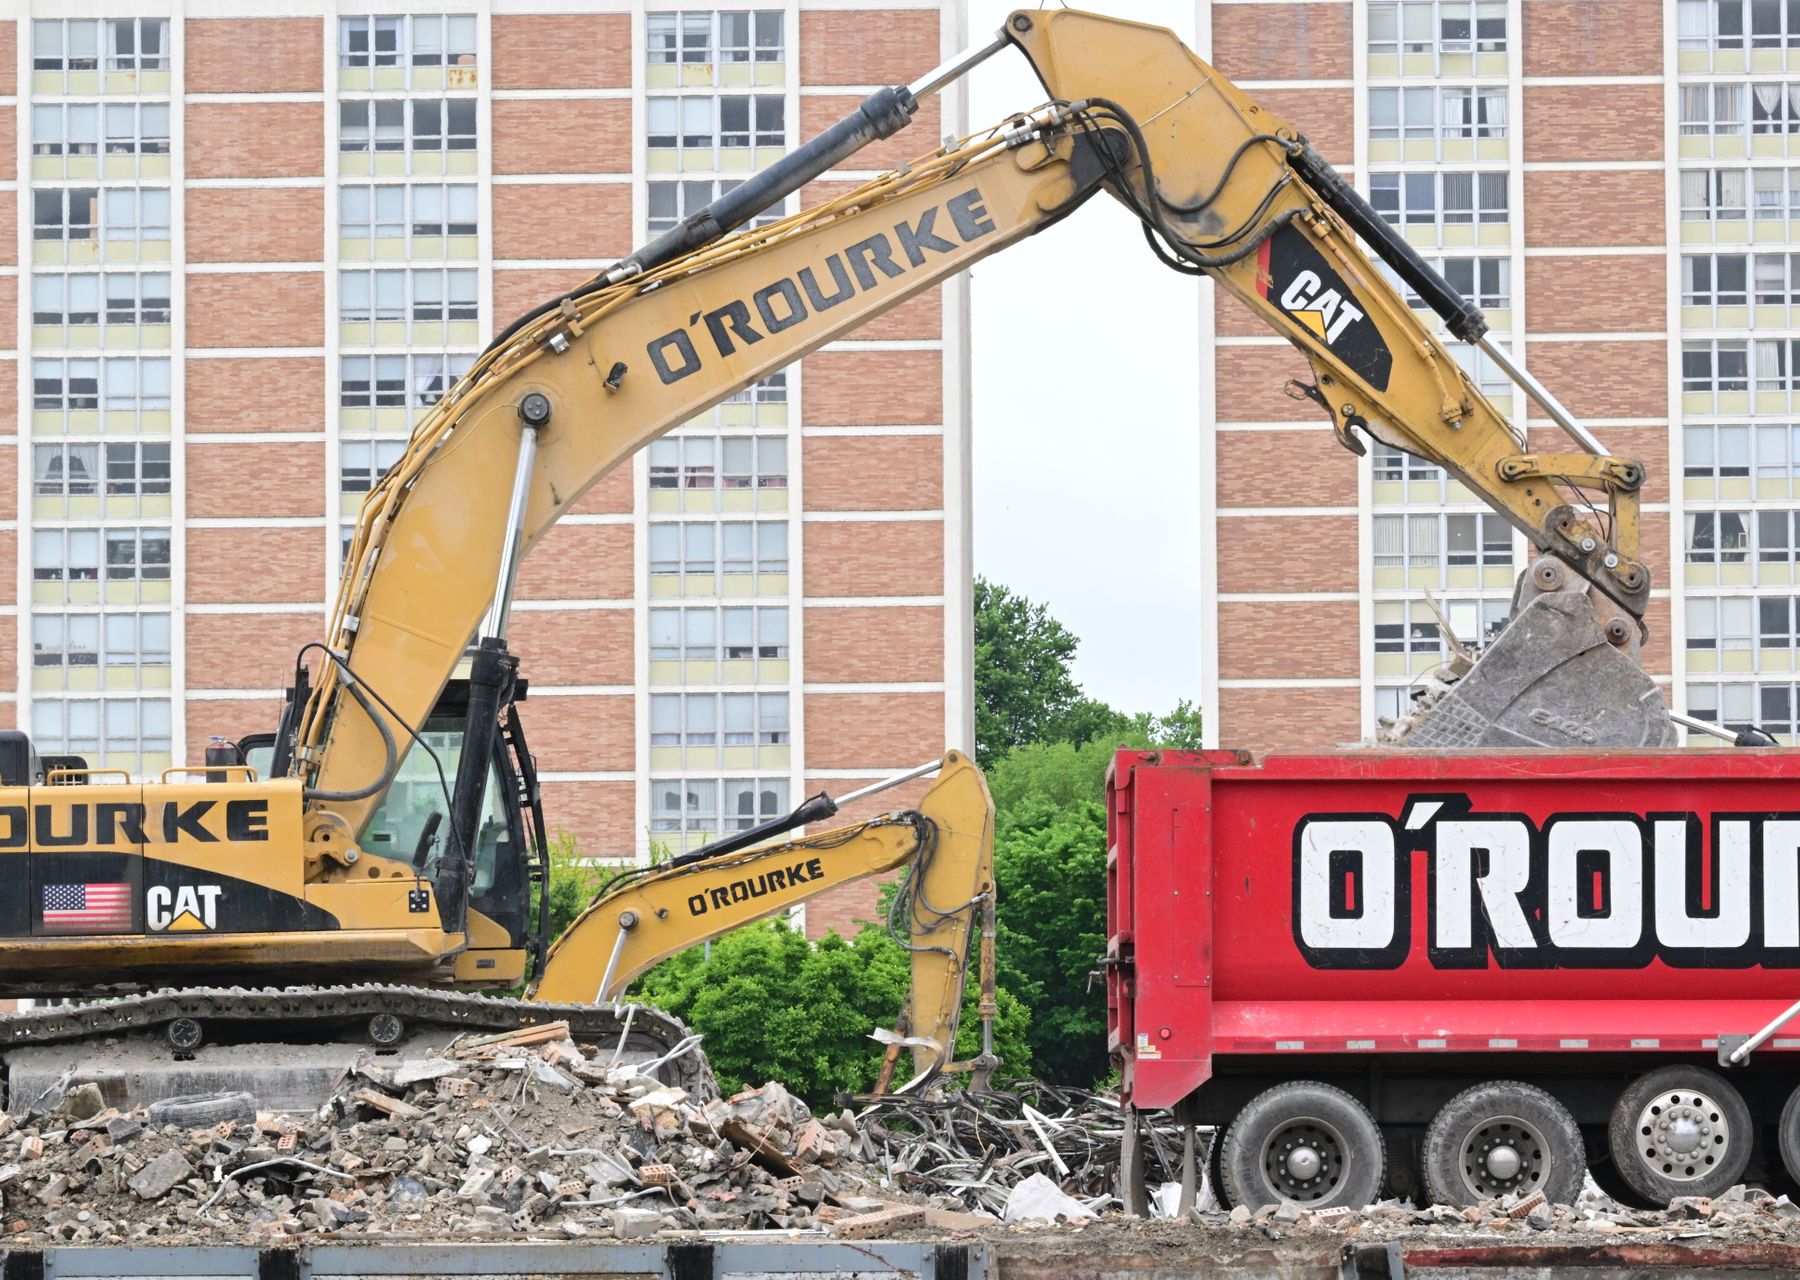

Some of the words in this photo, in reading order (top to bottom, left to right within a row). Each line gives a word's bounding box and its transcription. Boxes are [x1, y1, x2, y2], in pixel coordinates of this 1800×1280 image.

[646, 187, 997, 385] O'ROURKE
[1280, 269, 1364, 345] CAT
[147, 885, 222, 931] CAT
[688, 858, 825, 917] O'ROURKE
